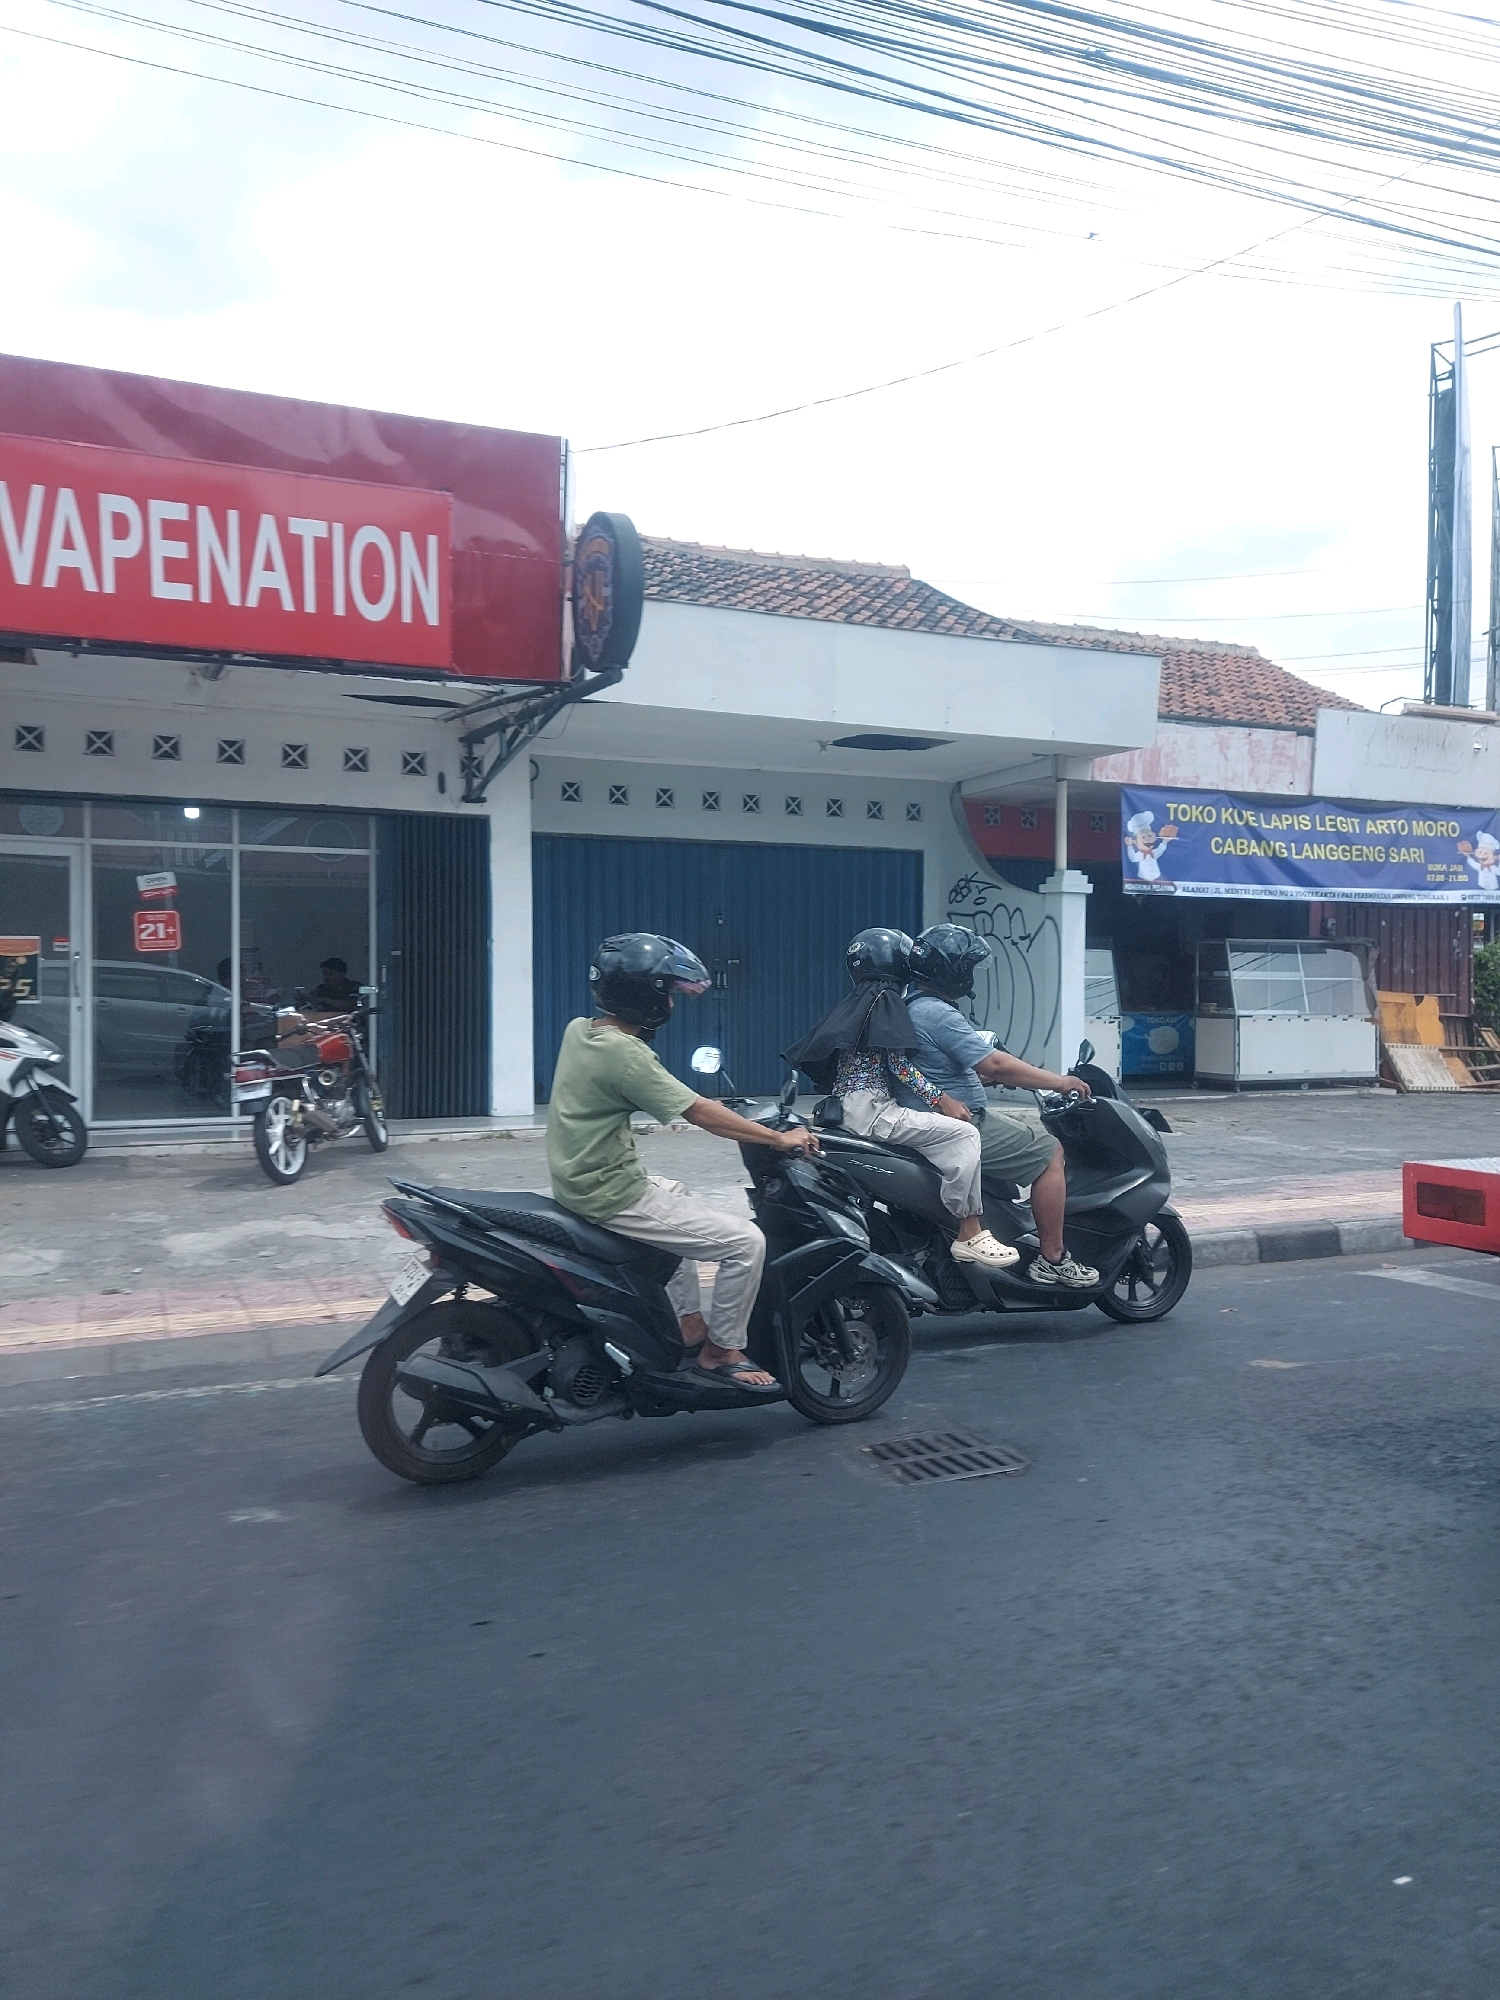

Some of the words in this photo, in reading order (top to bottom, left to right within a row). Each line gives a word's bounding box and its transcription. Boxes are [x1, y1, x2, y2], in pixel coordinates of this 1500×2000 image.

[0, 481, 441, 627] VAPENATION
[1166, 803, 1217, 824] TOKO
[1221, 807, 1258, 827] KUE
[1259, 812, 1312, 831] LAPIS
[1315, 815, 1360, 834] LEGIT
[1366, 819, 1409, 836] ARTO
[1412, 820, 1460, 838] MORO
[1210, 836, 1288, 858] CABANG
[1290, 842, 1386, 863] LANGGENG
[1388, 846, 1425, 863] SARI
[138, 922, 177, 940] 21+
